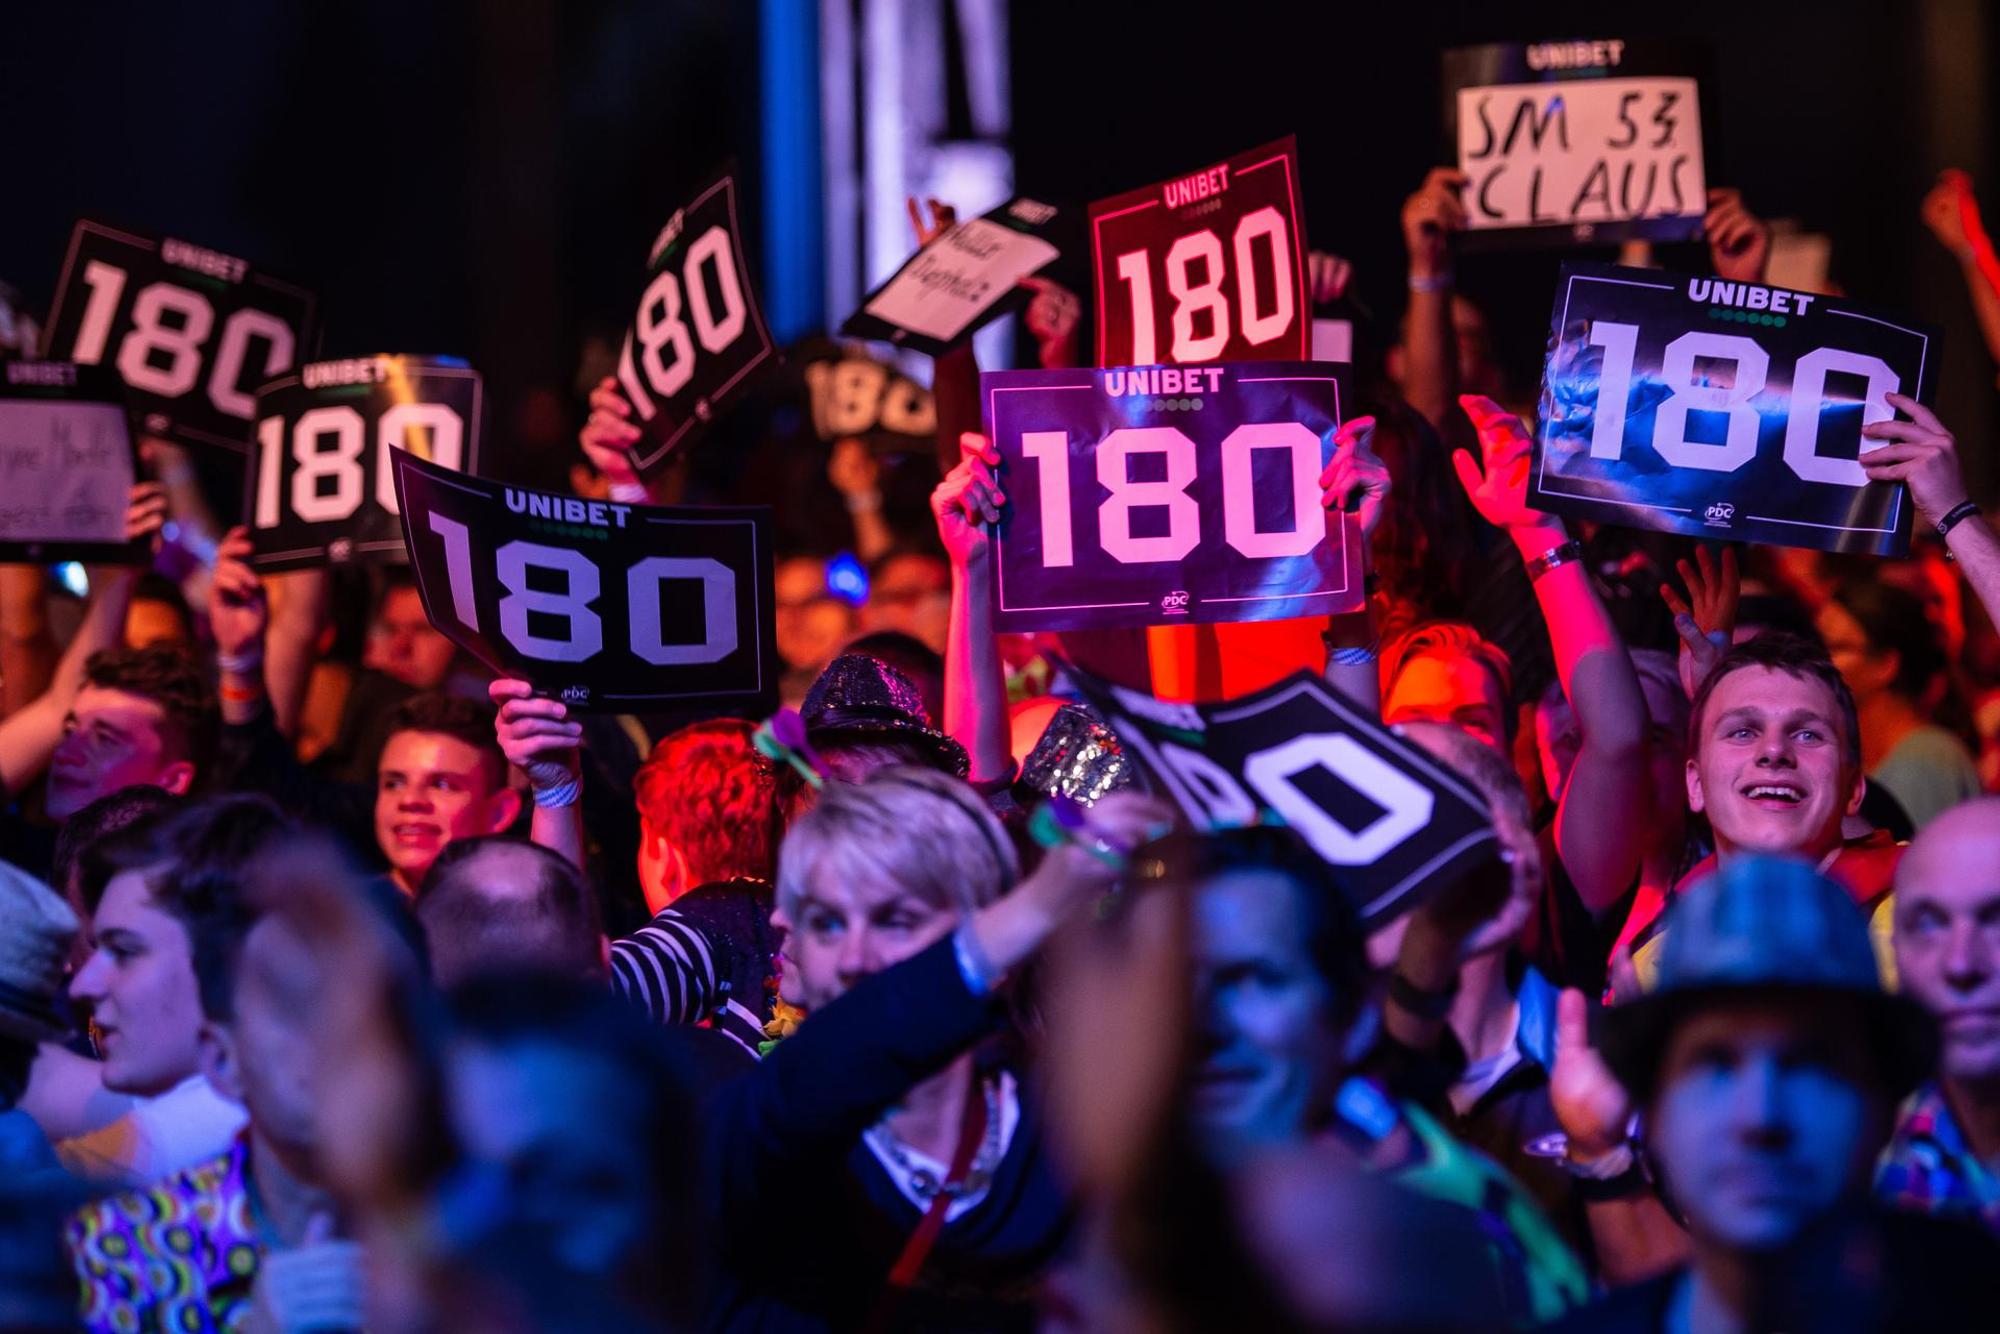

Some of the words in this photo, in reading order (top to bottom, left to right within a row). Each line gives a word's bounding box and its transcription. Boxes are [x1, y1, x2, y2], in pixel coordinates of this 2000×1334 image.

[1527, 40, 1624, 70] UNIBET
[1468, 93, 1570, 158] SM
[1164, 164, 1230, 210] UNIBET
[1479, 154, 1689, 224] CLAUS
[161, 238, 249, 284] UNIBET
[1117, 206, 1294, 365] 180
[1687, 277, 1814, 316] UNIBET
[72, 259, 295, 420] 180
[303, 356, 388, 388] UNIBET
[1105, 368, 1224, 397] UNIBET
[1588, 320, 1900, 487] 180
[256, 403, 464, 528] 180
[1021, 422, 1326, 568] 180
[505, 487, 631, 528] UNIBET
[428, 510, 738, 665] 180
